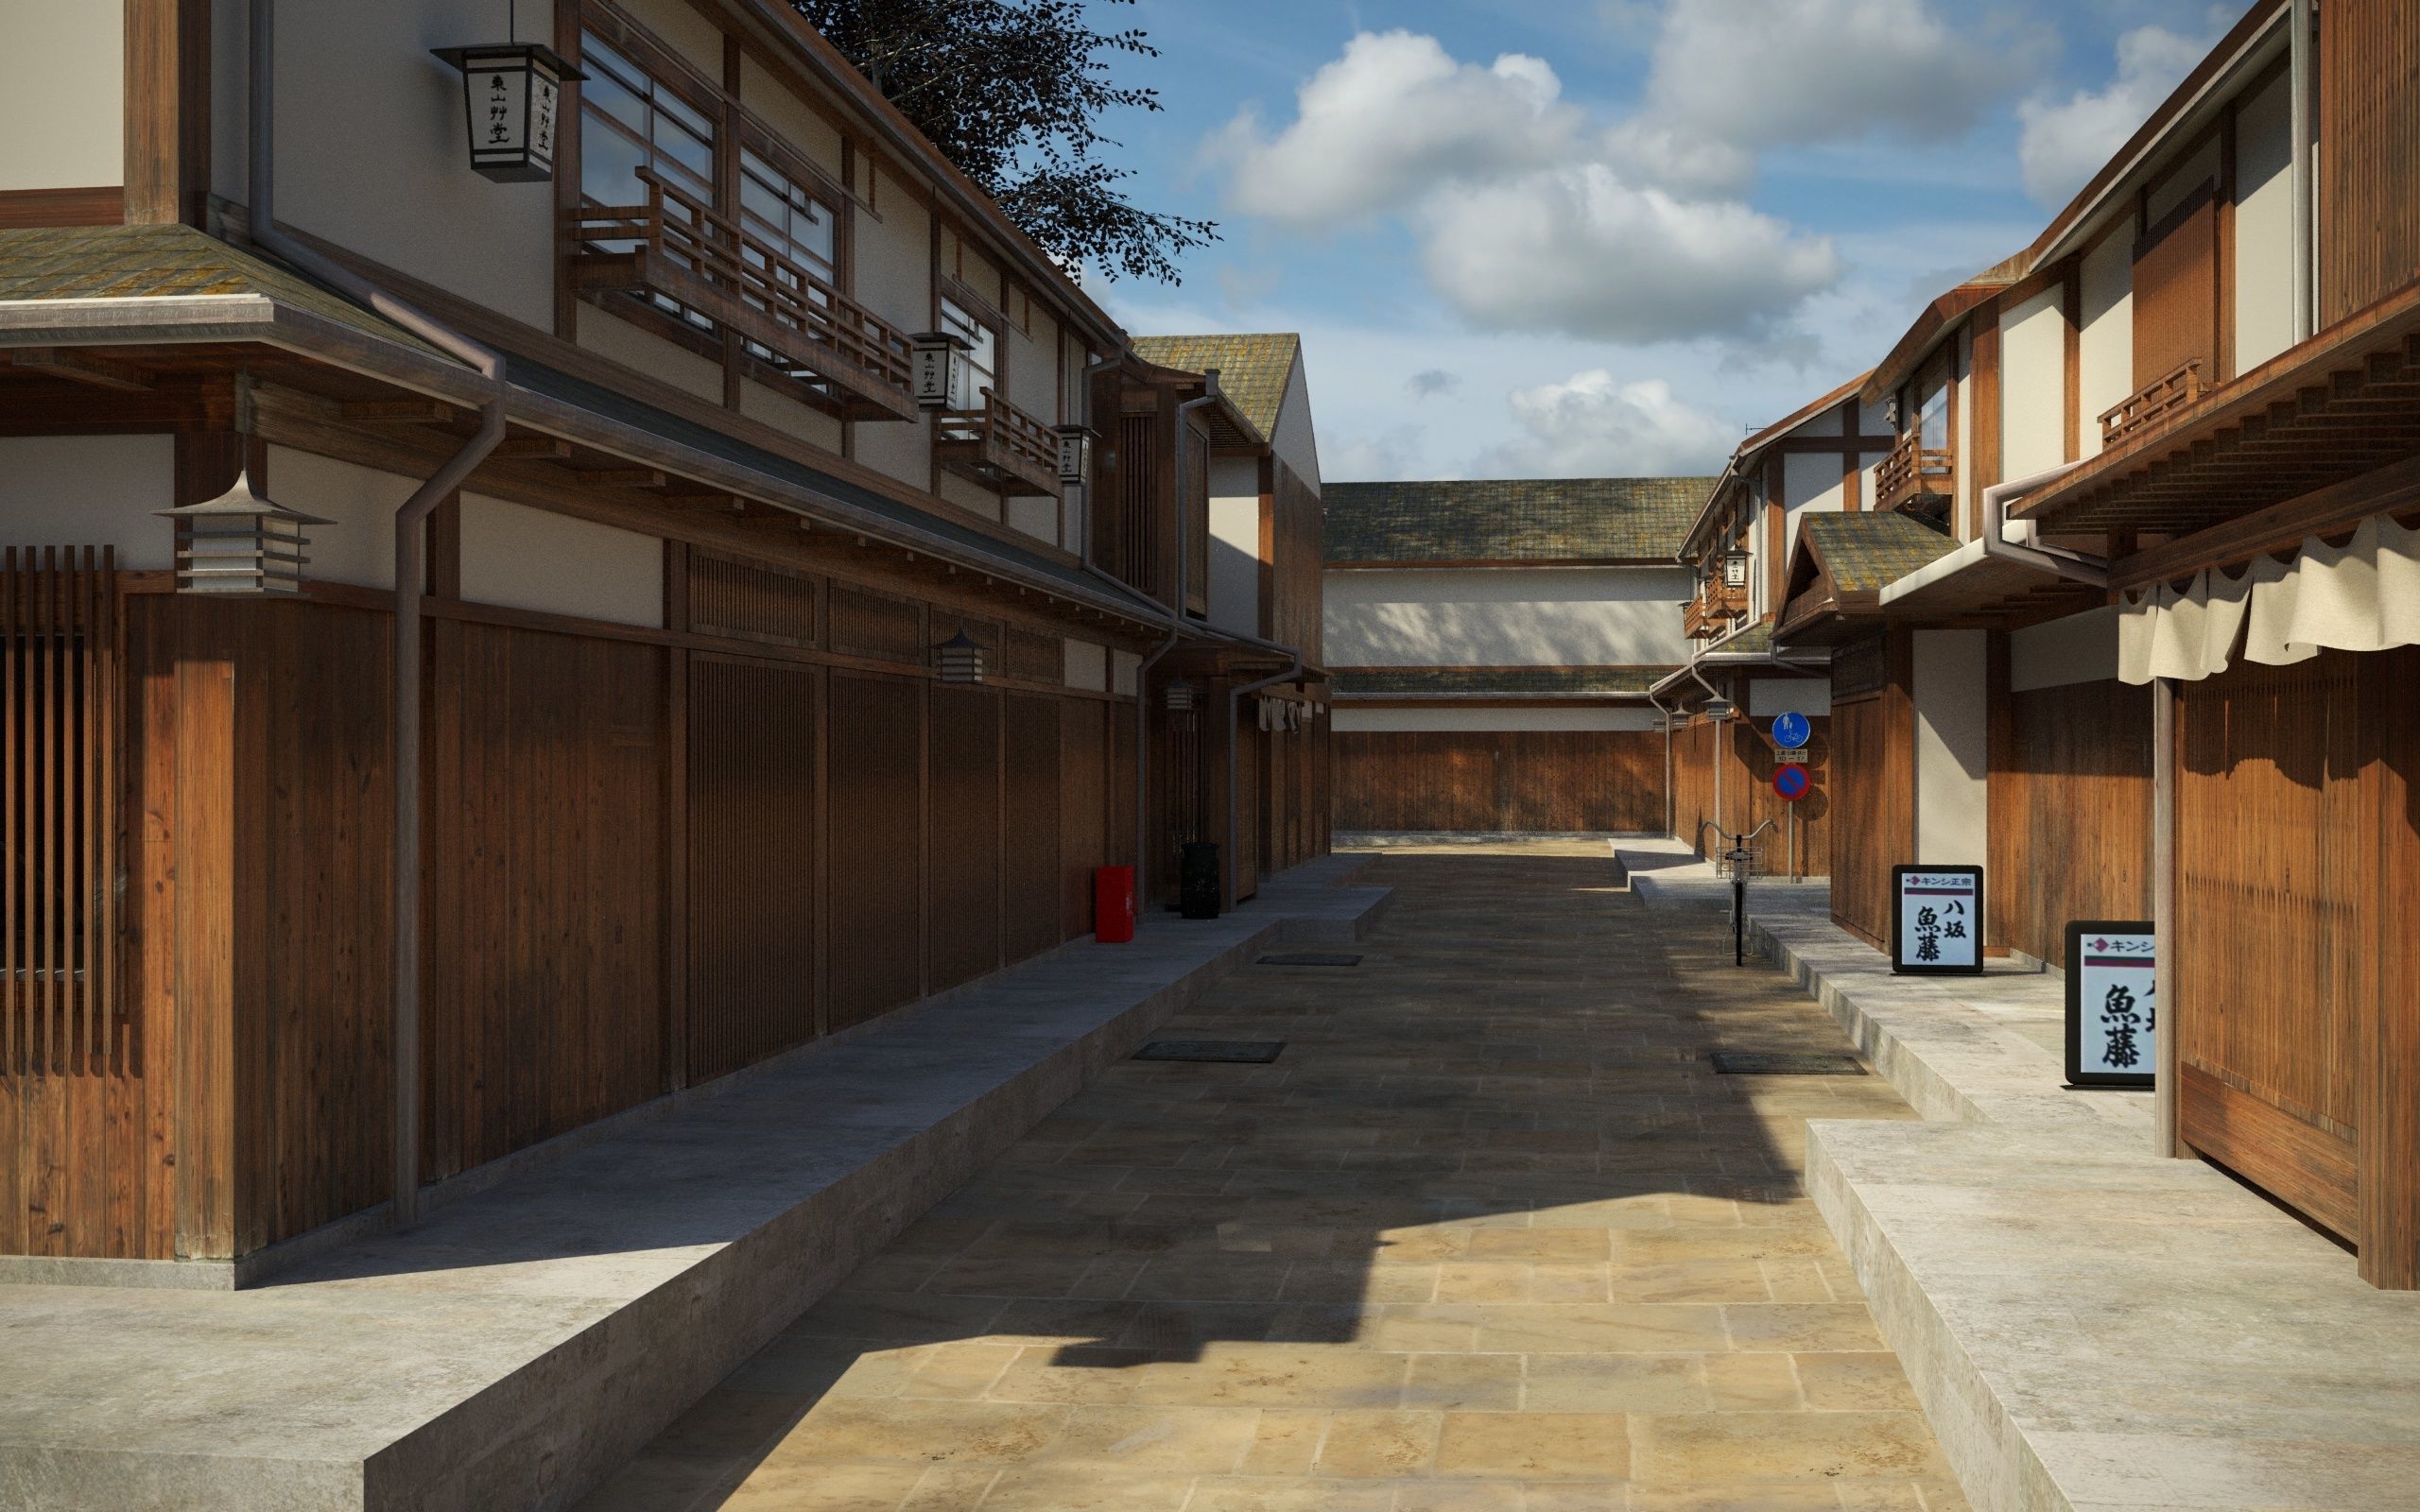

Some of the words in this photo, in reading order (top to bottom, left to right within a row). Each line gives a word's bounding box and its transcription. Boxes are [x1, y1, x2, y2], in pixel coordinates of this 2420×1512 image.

[1914, 906, 1942, 962] 魚藤
[1944, 900, 1966, 938] 八坂
[2100, 984, 2141, 1068] 魚藤
